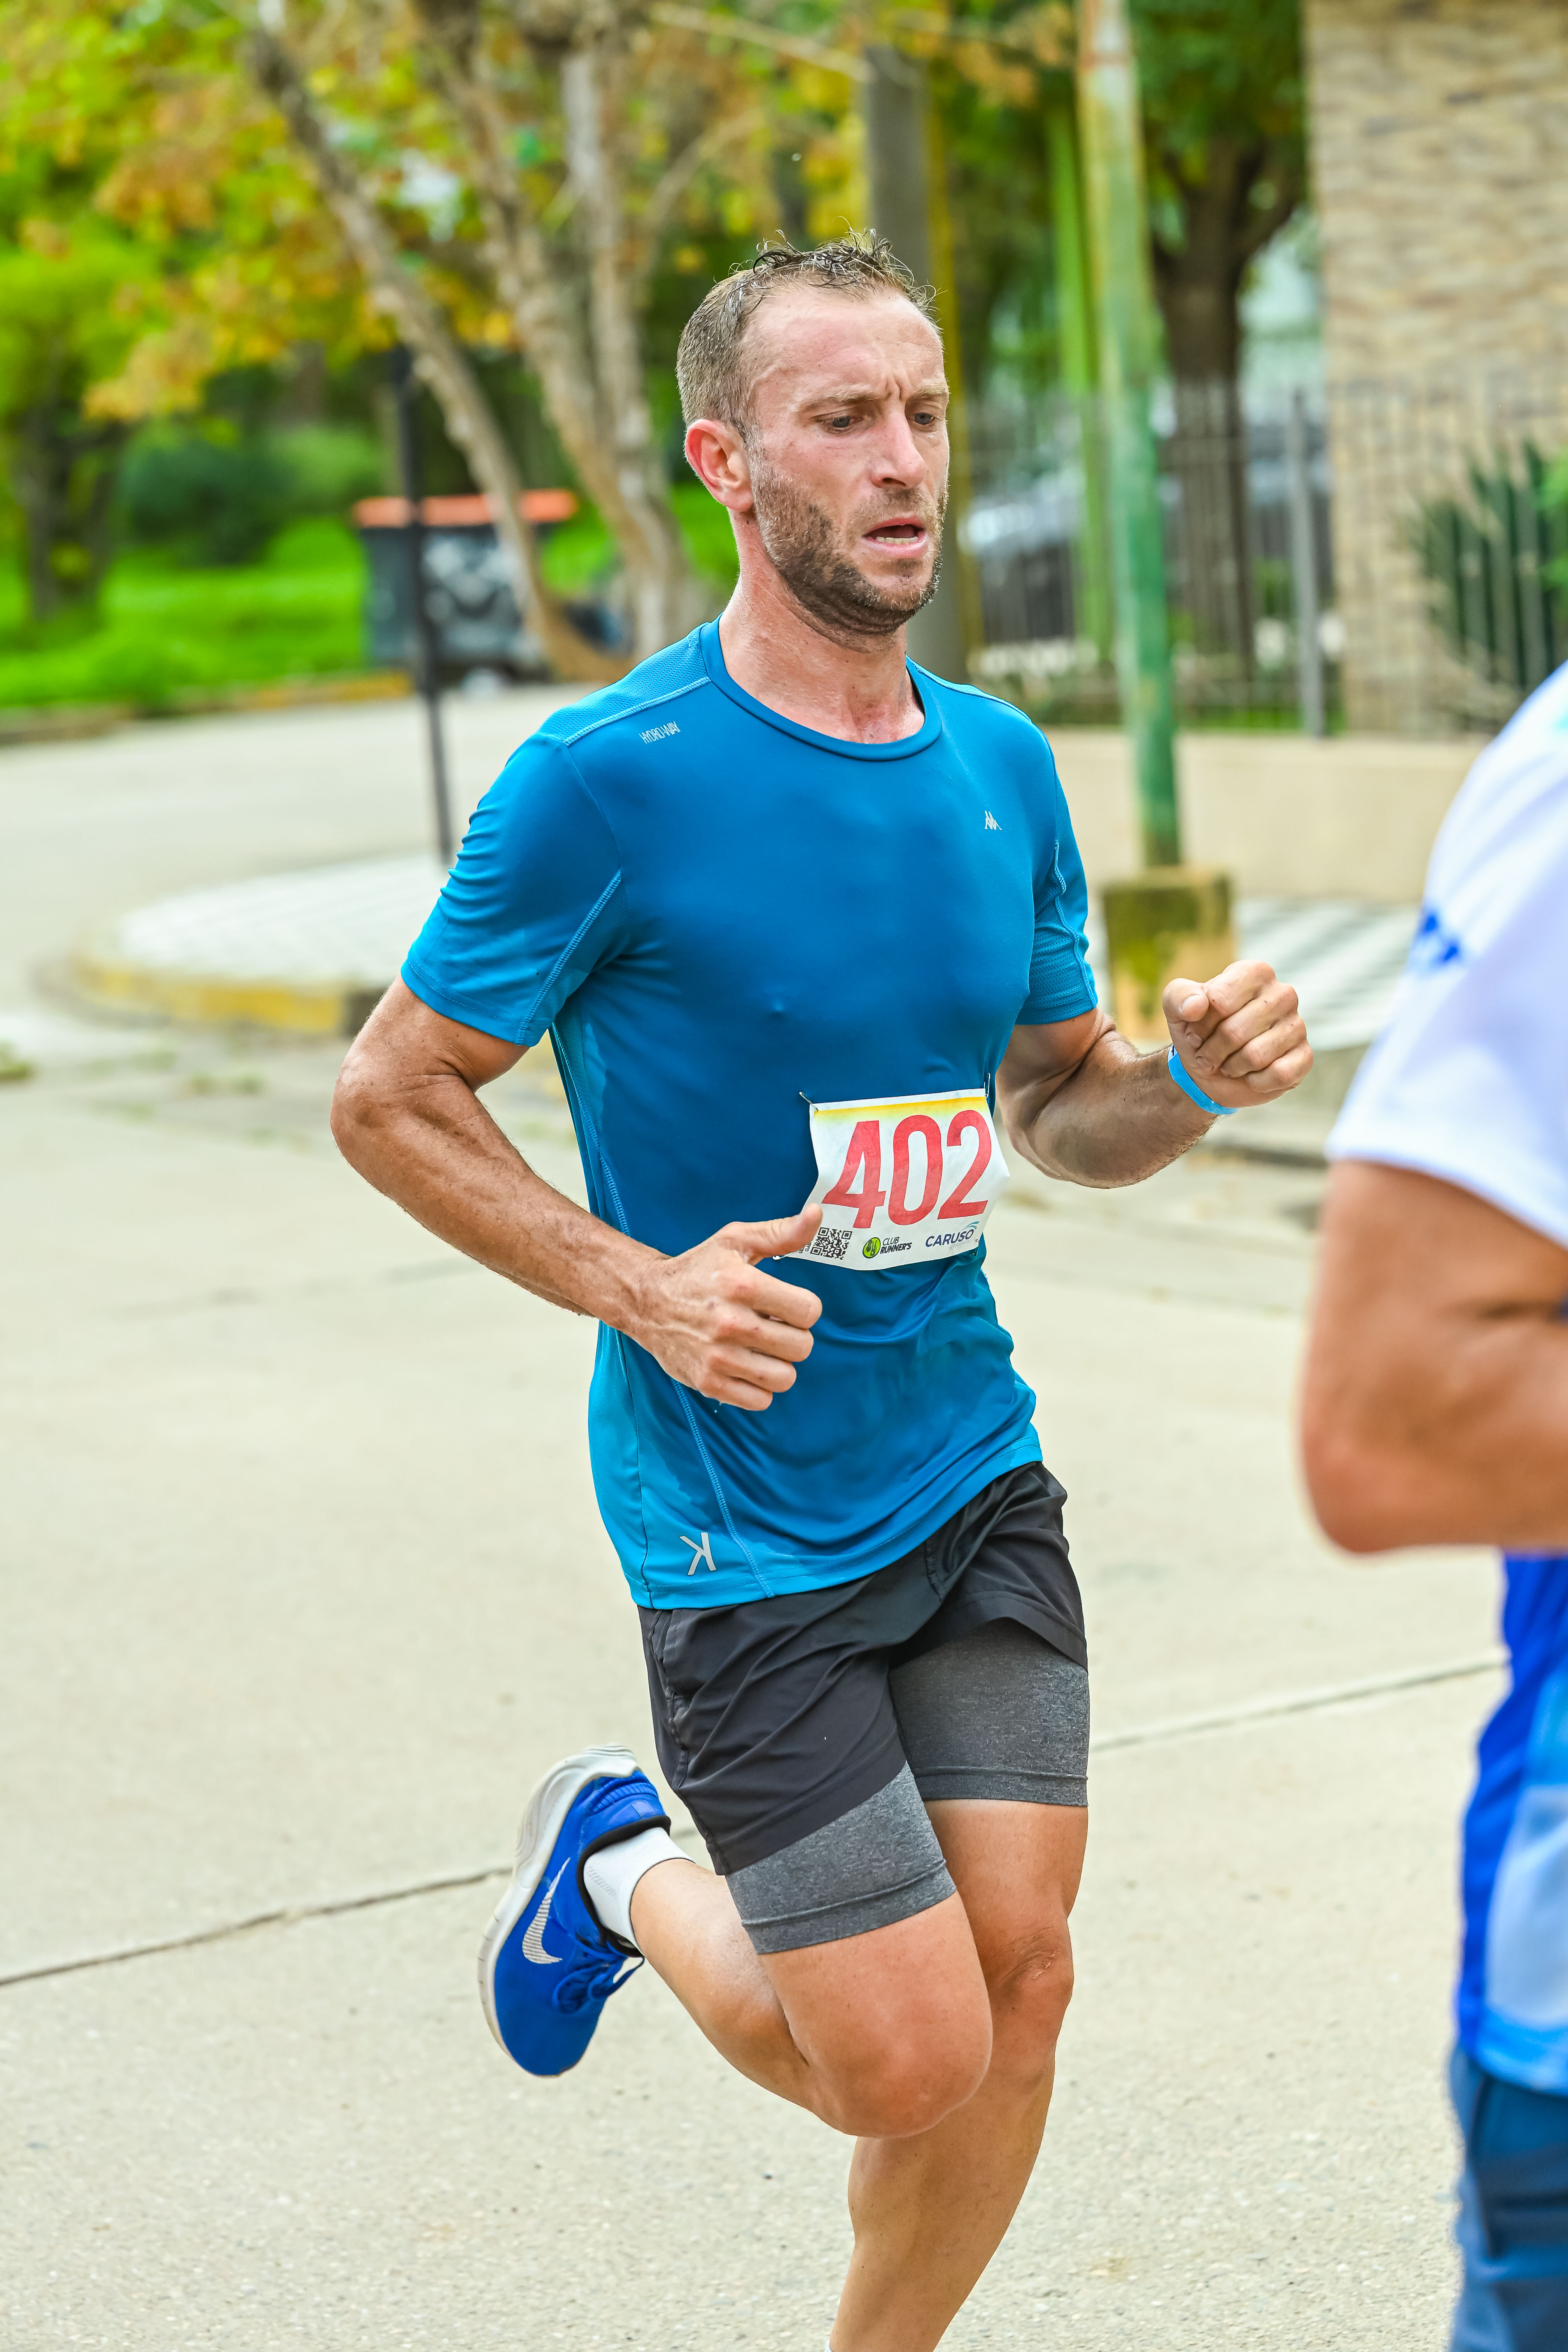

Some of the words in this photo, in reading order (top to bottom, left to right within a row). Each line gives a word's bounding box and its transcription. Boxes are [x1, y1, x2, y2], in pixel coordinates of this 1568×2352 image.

[821, 1110, 992, 1228] 402
[882, 1236, 900, 1246] CLUB
[925, 1229, 974, 1247] CARUSO
[880, 1242, 912, 1254] RUNNER'S
